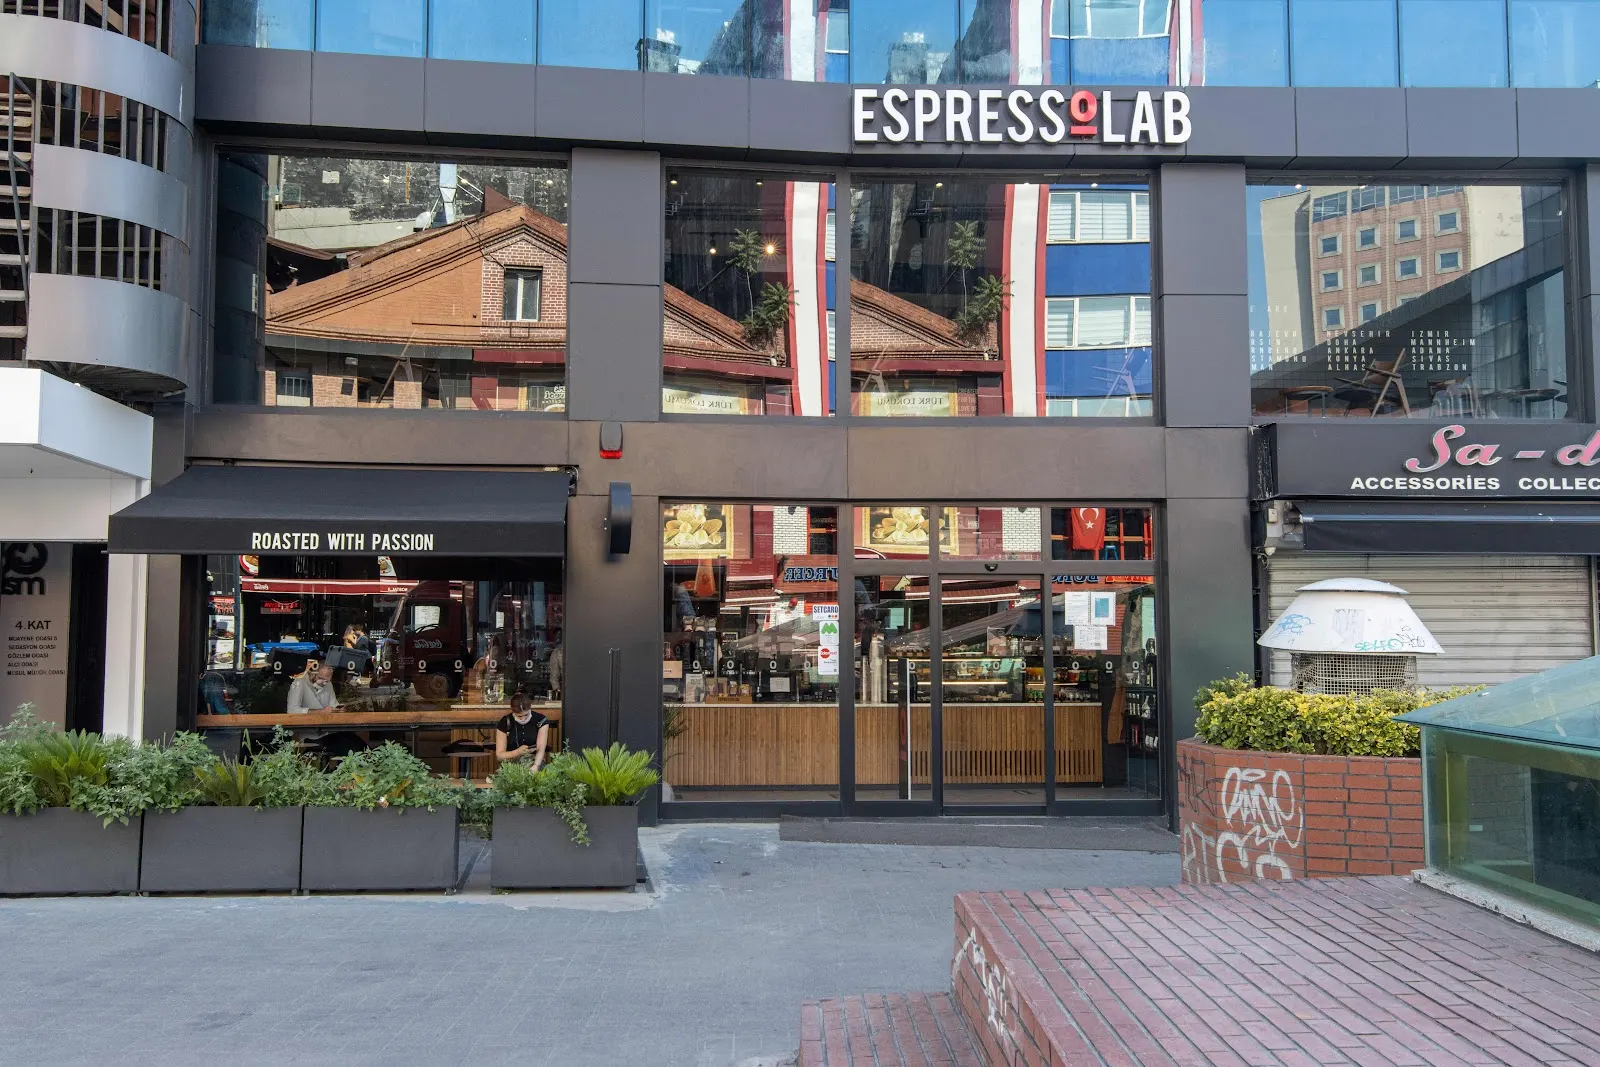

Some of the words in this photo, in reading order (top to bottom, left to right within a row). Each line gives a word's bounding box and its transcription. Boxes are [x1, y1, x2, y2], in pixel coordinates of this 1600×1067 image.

[853, 88, 1192, 144] ESPRESSOLAB
[252, 532, 319, 550] ROASTED
[328, 533, 364, 550] WITH
[372, 533, 434, 551] PASSION
[814, 606, 838, 614] SETCARD
